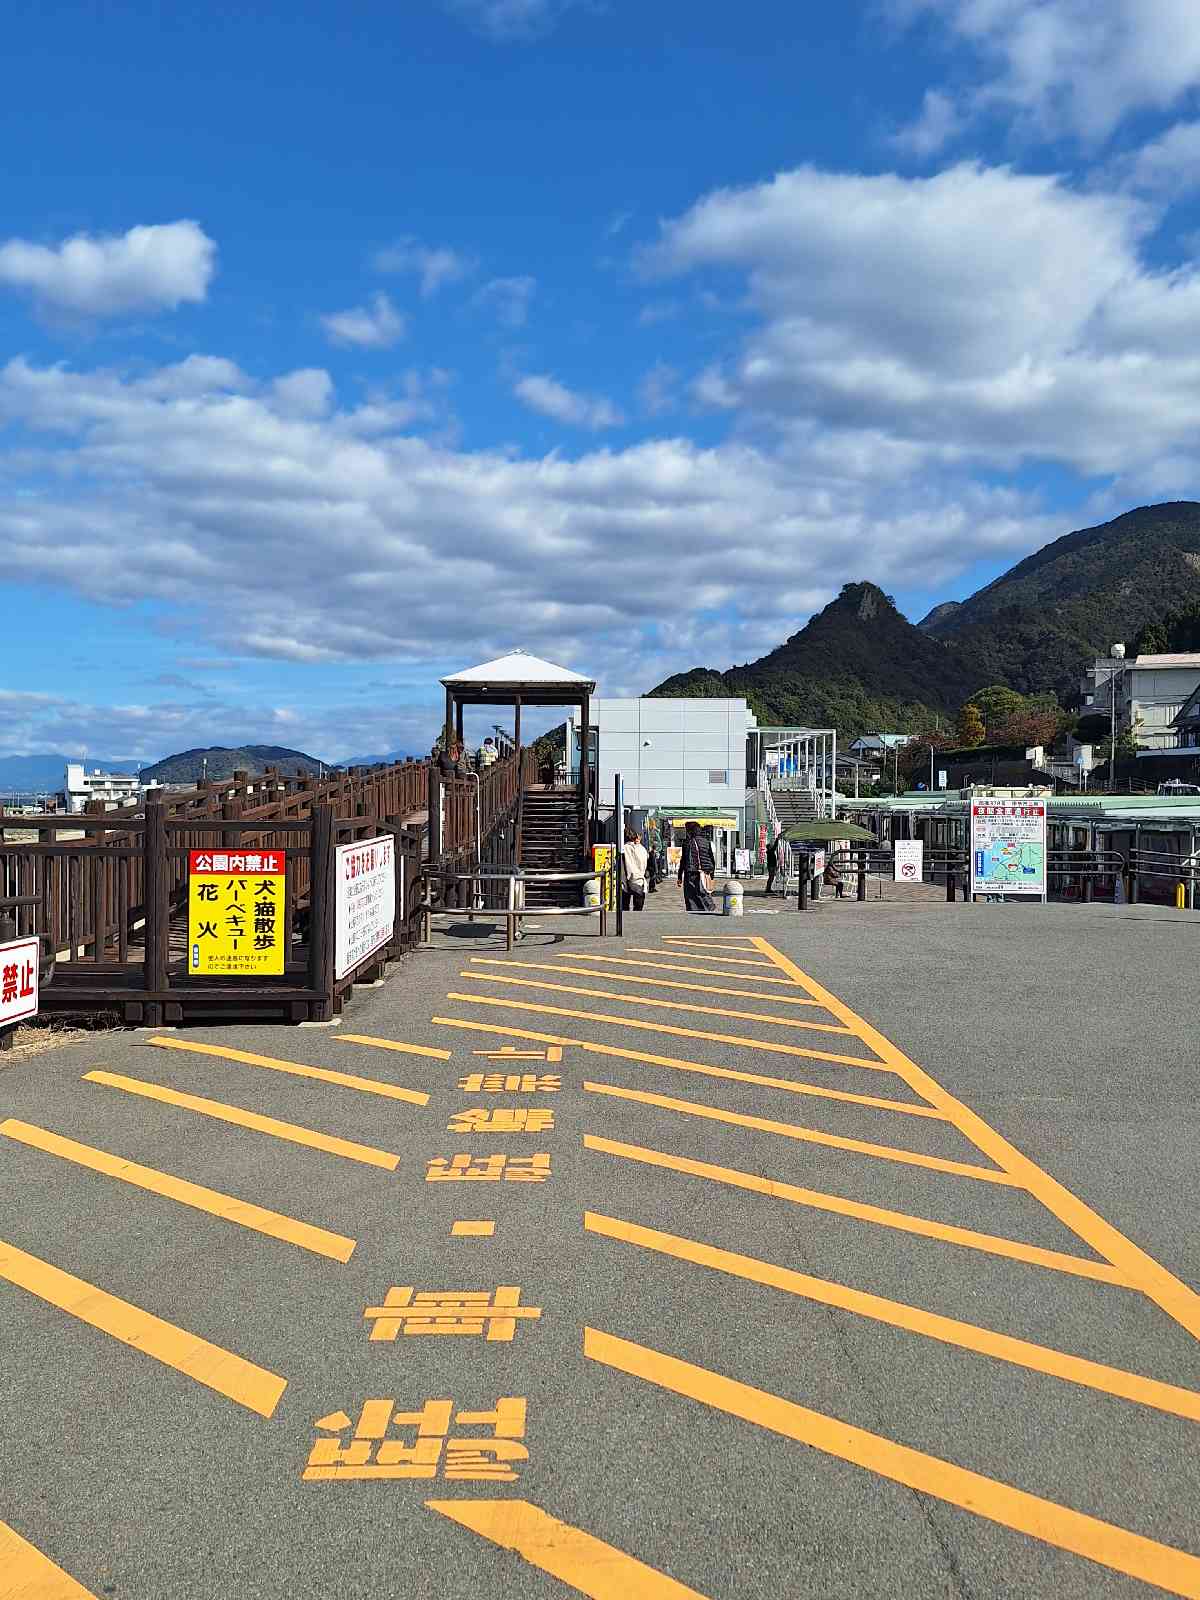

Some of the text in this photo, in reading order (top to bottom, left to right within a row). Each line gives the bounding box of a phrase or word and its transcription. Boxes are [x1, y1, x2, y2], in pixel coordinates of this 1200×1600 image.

[196, 854, 278, 872] 公園内禁止
[197, 883, 219, 939] 花火
[225, 879, 248, 950] バーベキュー
[253, 879, 276, 950] 犬・猫散歩
[2, 960, 33, 1004] 禁止
